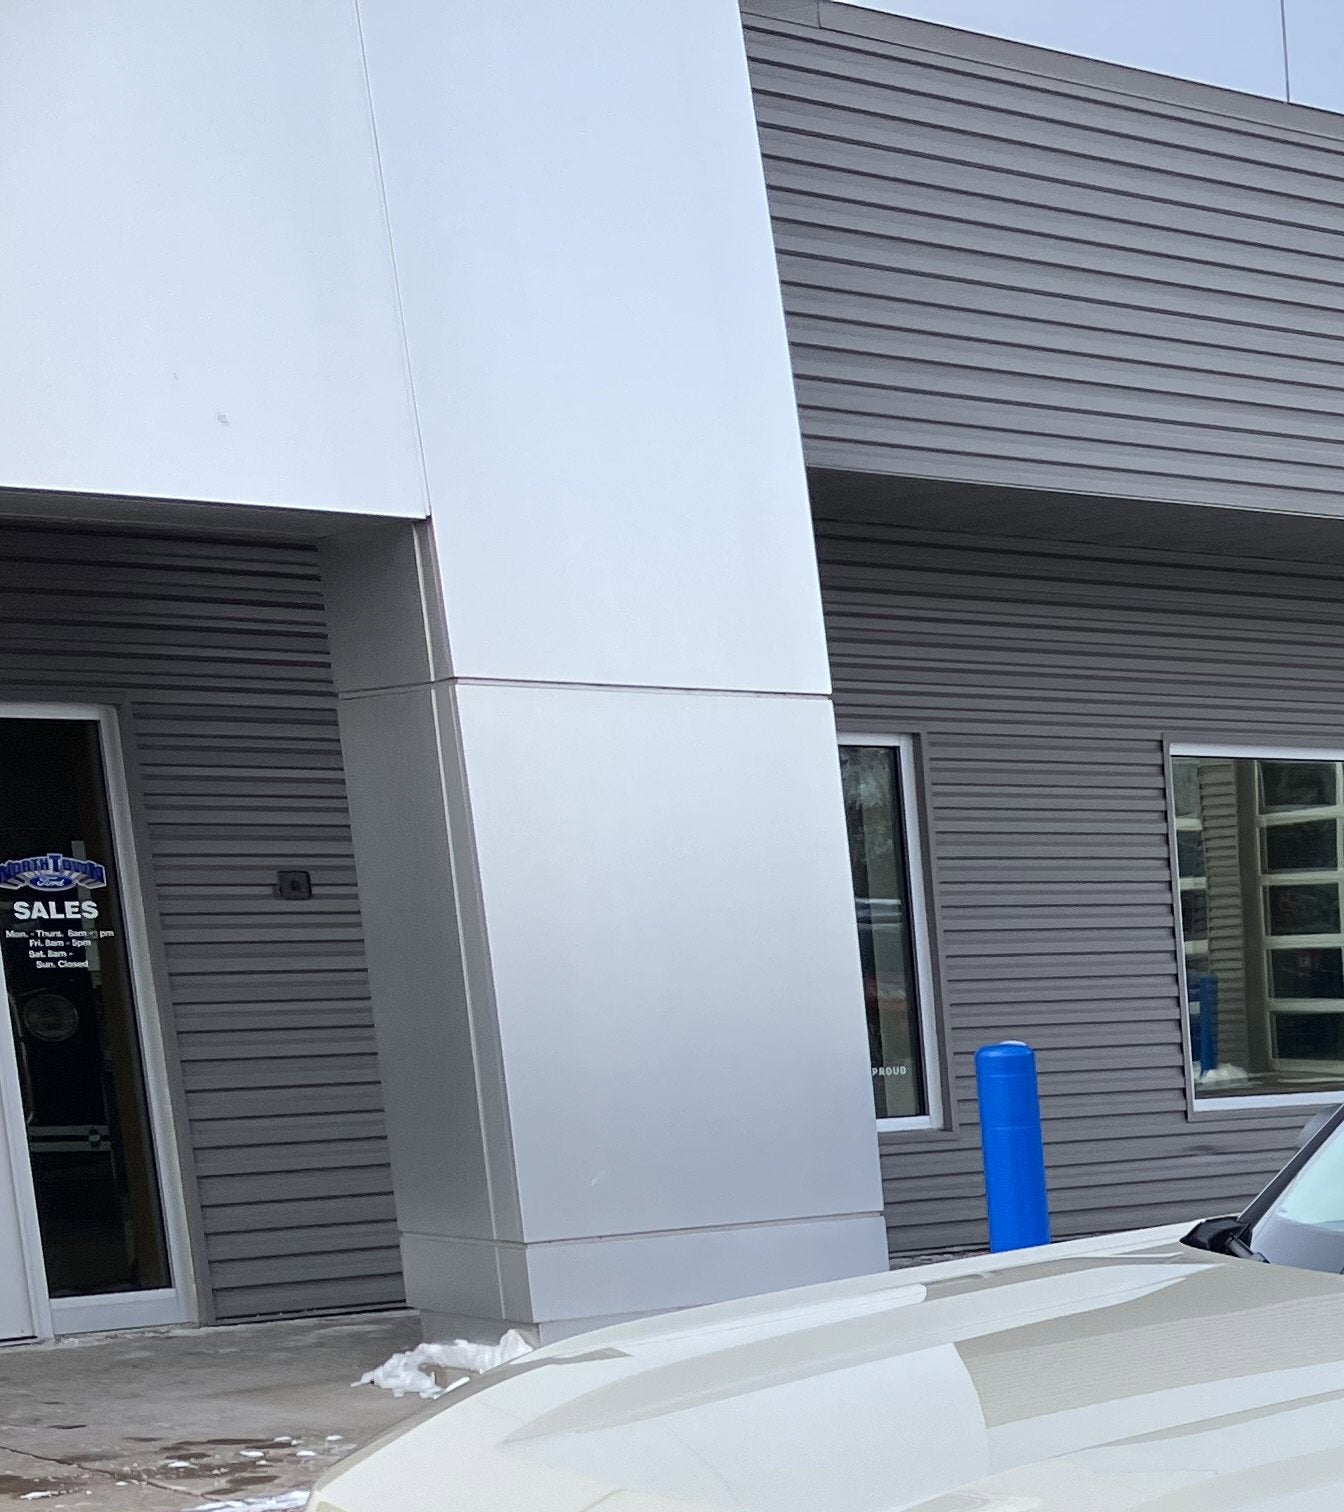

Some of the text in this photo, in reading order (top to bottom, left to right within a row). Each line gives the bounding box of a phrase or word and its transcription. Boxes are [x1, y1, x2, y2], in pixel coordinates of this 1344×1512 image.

[37, 876, 65, 887] Ford
[13, 901, 99, 920] SALES
[57, 960, 89, 969] Closed
[871, 1065, 907, 1077] PROUD
